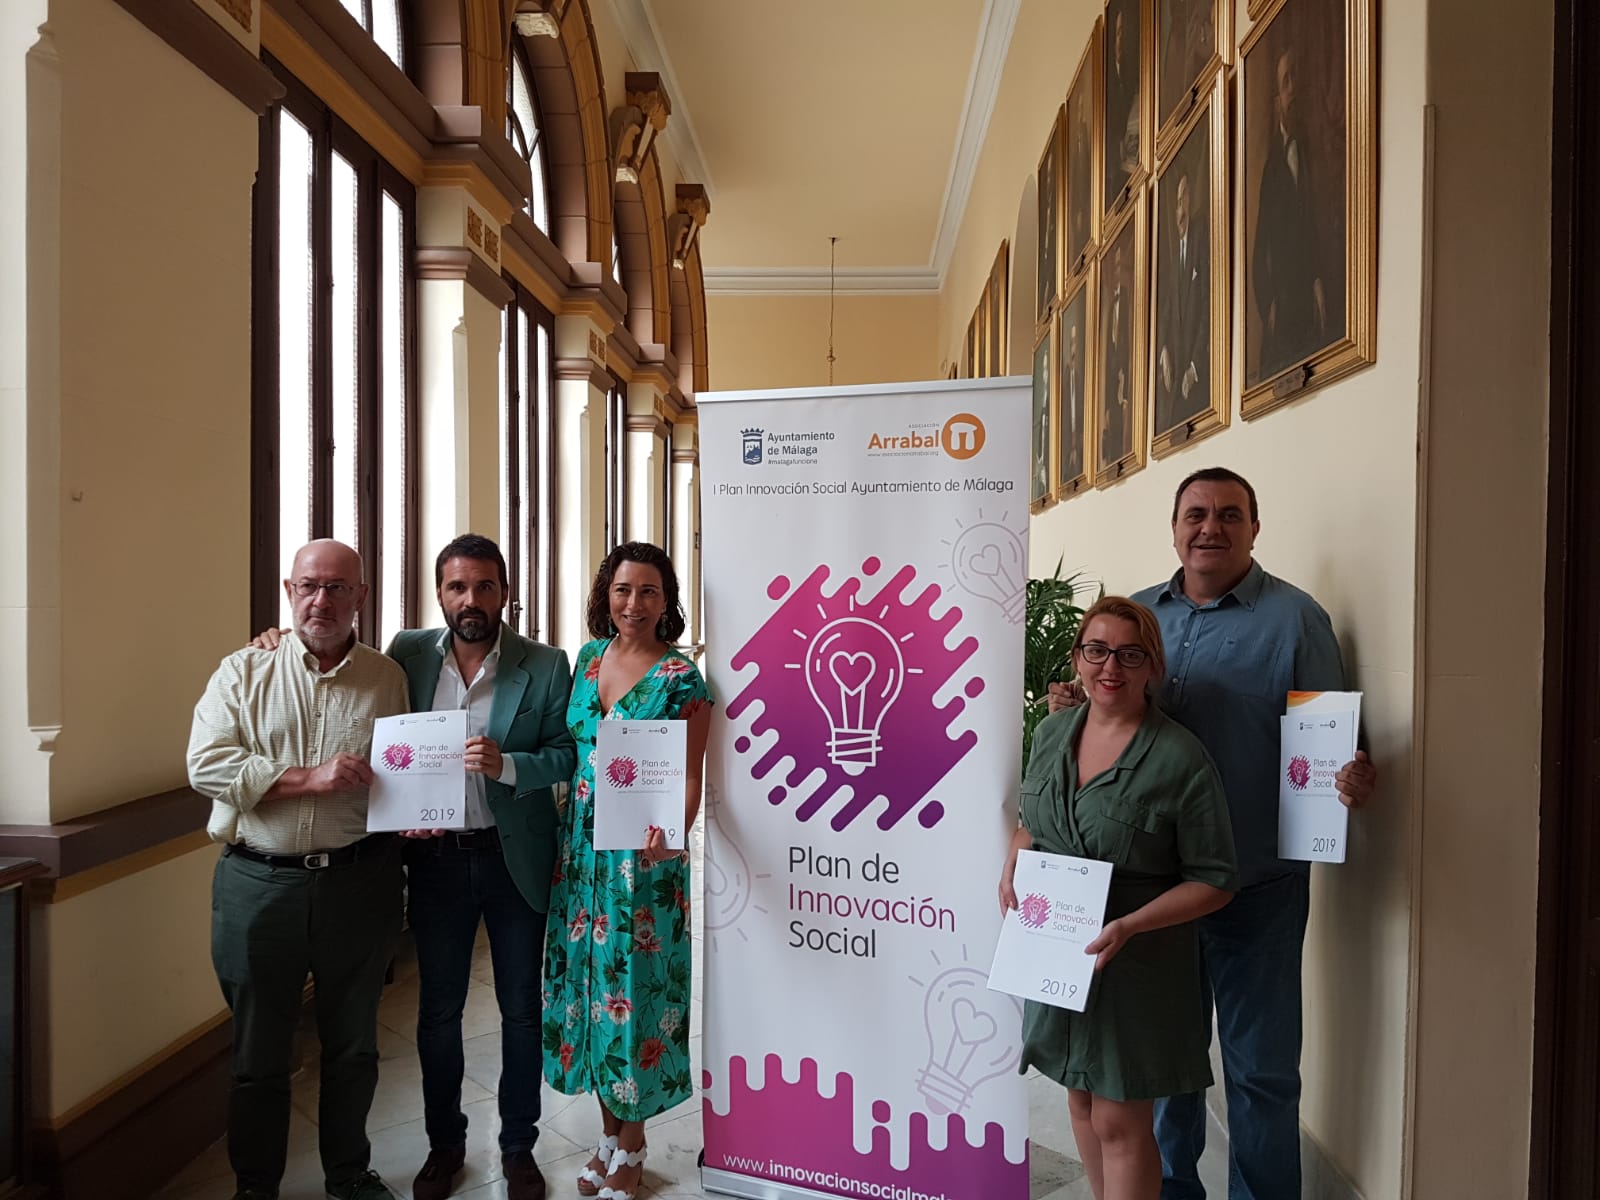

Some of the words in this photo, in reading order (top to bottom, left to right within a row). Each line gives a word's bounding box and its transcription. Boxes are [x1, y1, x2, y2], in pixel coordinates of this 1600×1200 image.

[767, 432, 835, 444] Ayuntamiento
[867, 429, 939, 449] Arrabal
[767, 446, 779, 455] de
[782, 445, 818, 457] Málaga
[719, 483, 743, 495] Plan
[746, 481, 809, 495] Innovación
[812, 481, 847, 494] Social
[850, 480, 942, 495] Ayuntamiento
[944, 479, 960, 491] de
[963, 477, 1014, 493] Málaga
[418, 752, 463, 760] Innovación
[1313, 758, 1328, 767] Plan
[1328, 759, 1337, 767] de
[641, 759, 659, 767] Plan
[1313, 769, 1335, 778] Innova
[1313, 779, 1331, 788] Social
[420, 808, 455, 821] 2019
[1312, 837, 1337, 853] 2019
[788, 846, 851, 879] Plan
[861, 853, 900, 883] de
[788, 883, 956, 933] Innovación
[1055, 901, 1074, 911] Plan
[1074, 904, 1086, 914] de
[1053, 911, 1100, 927] Innovación
[1052, 922, 1077, 934] Social
[788, 920, 877, 958] Social
[1040, 978, 1079, 998] 2019
